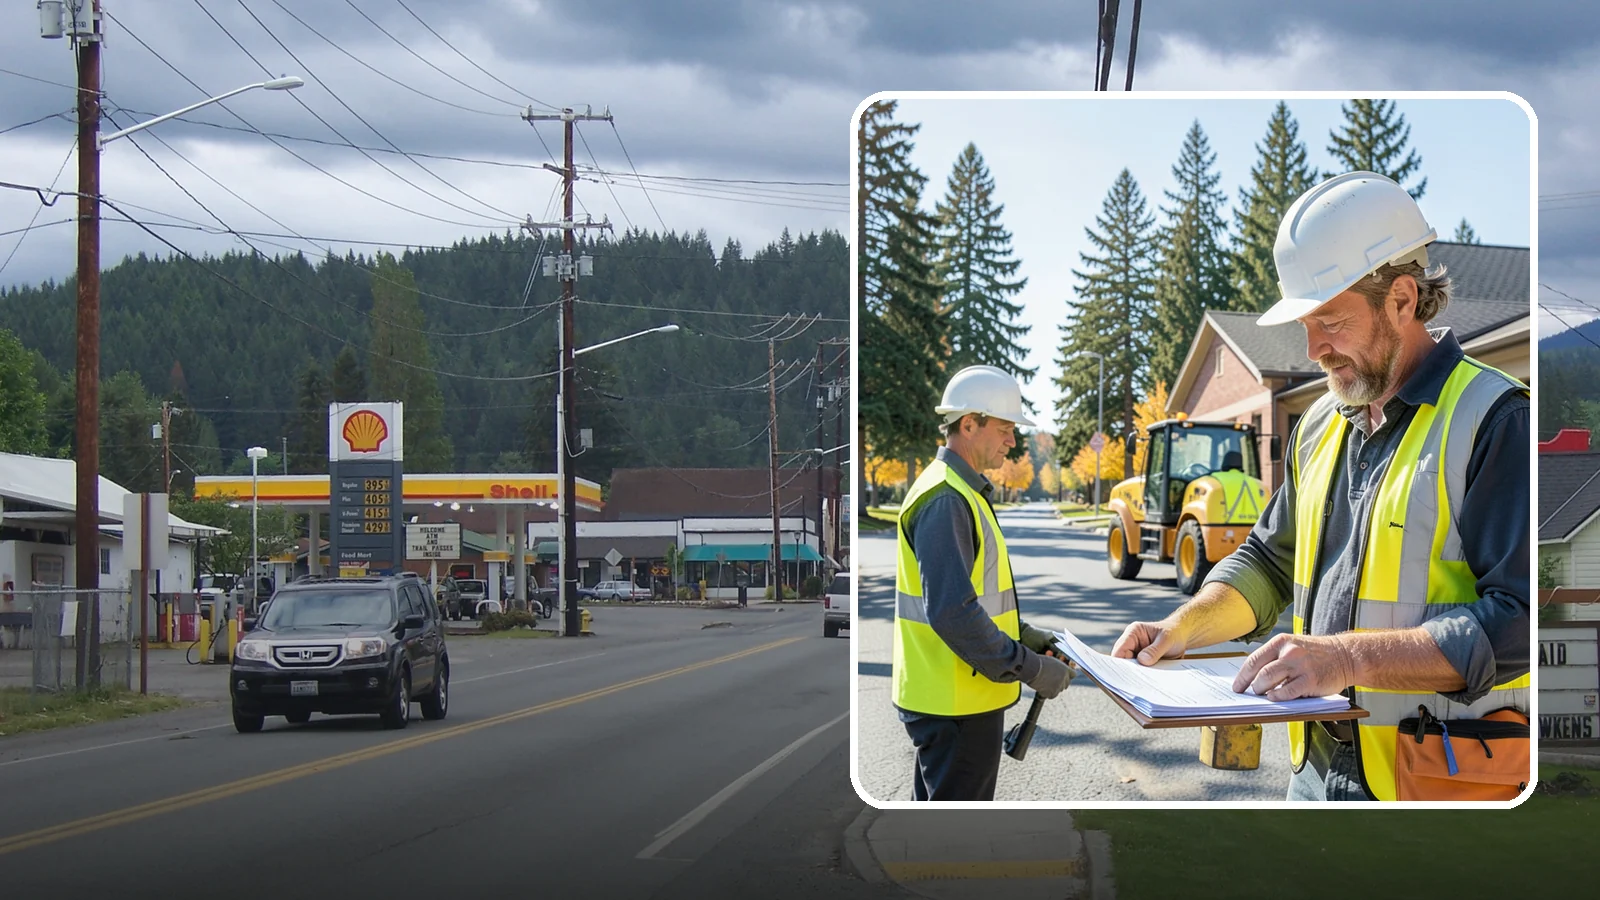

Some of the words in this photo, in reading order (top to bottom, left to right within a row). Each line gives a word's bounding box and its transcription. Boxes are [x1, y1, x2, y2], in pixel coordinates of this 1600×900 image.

[365, 480, 384, 490] 395
[490, 484, 547, 499] Shell
[365, 494, 384, 504] 405
[365, 508, 384, 518] 415
[365, 522, 384, 532] 429
[1538, 642, 1567, 665] AID
